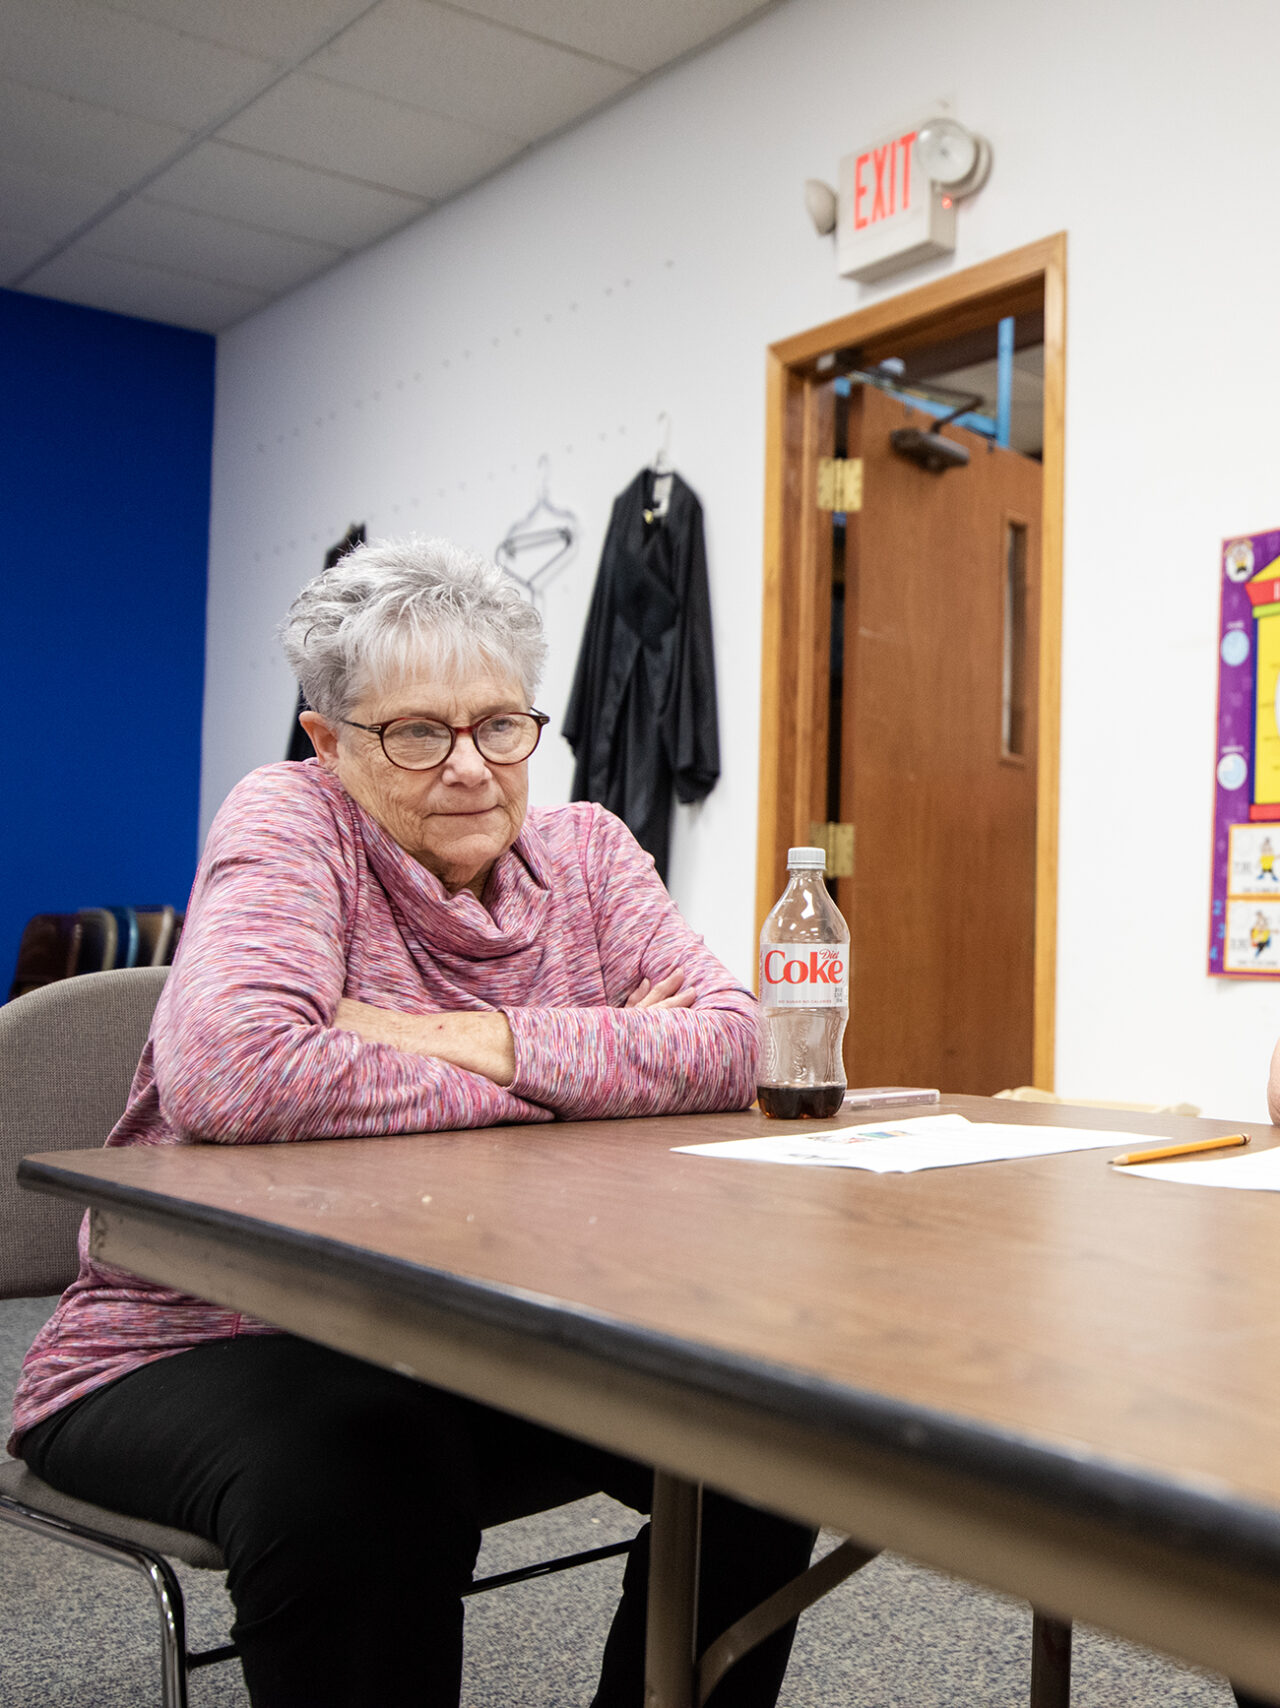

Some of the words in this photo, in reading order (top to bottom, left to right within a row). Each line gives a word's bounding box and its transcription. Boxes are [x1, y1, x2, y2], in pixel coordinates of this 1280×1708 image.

[855, 131, 916, 230] EXIT
[1274, 582, 1280, 600] I
[764, 949, 844, 985] Coke
[819, 948, 840, 960] Diet
